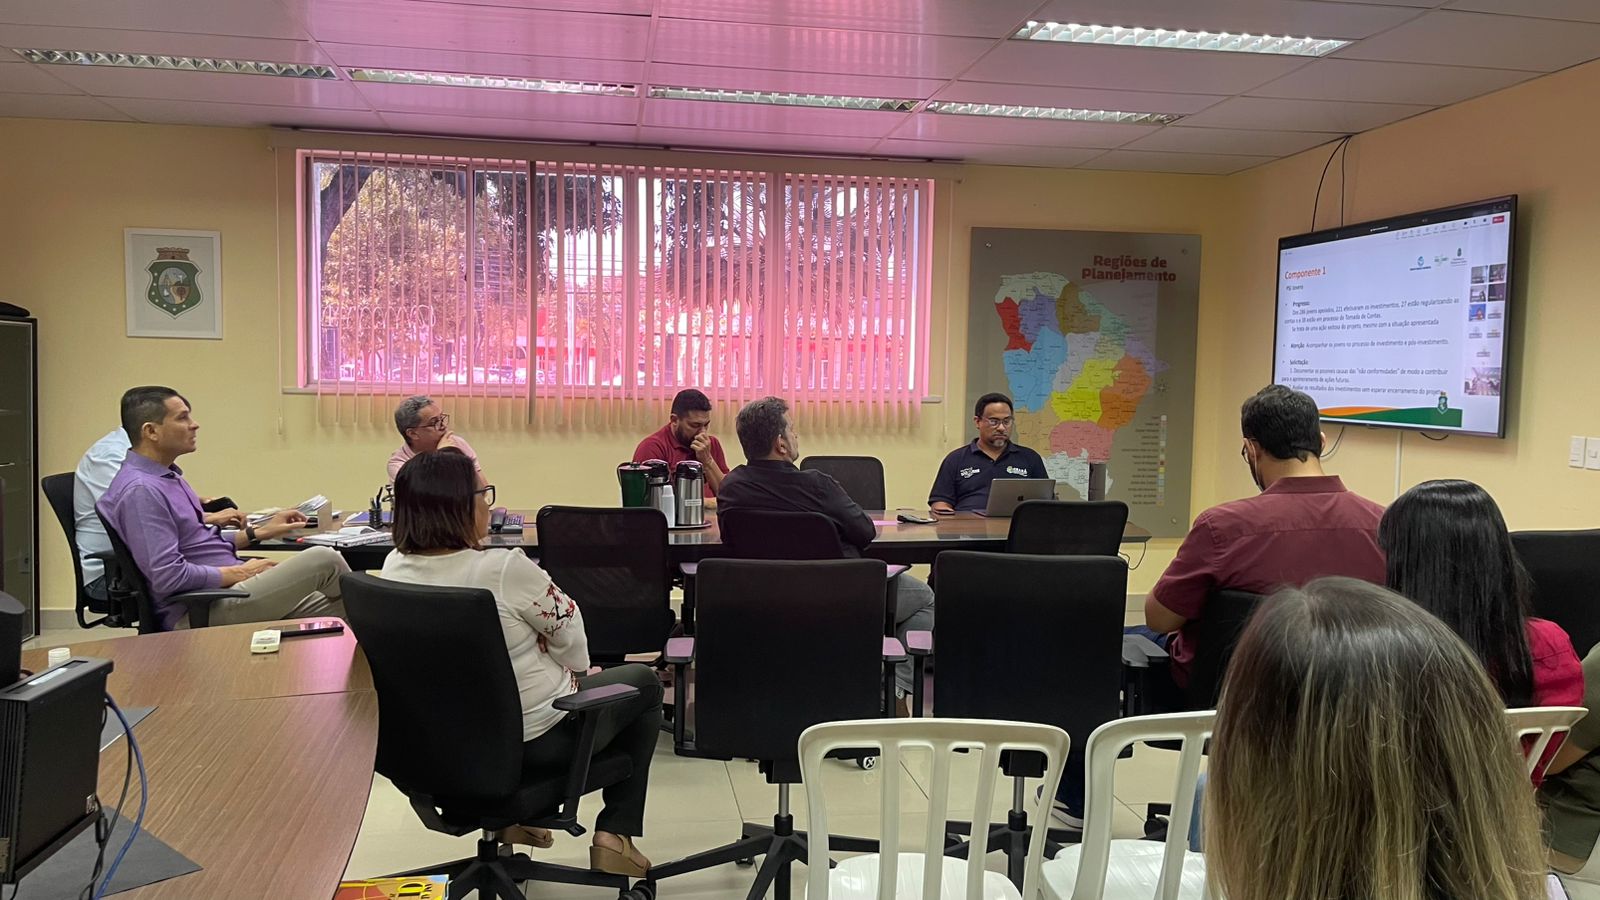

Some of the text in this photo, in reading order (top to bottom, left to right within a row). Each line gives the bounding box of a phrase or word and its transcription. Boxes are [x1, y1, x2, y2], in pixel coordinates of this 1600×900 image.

[1093, 255, 1167, 269] Regiões de
[1082, 268, 1176, 282] Planejamento
[1284, 266, 1326, 280] Componente 1
